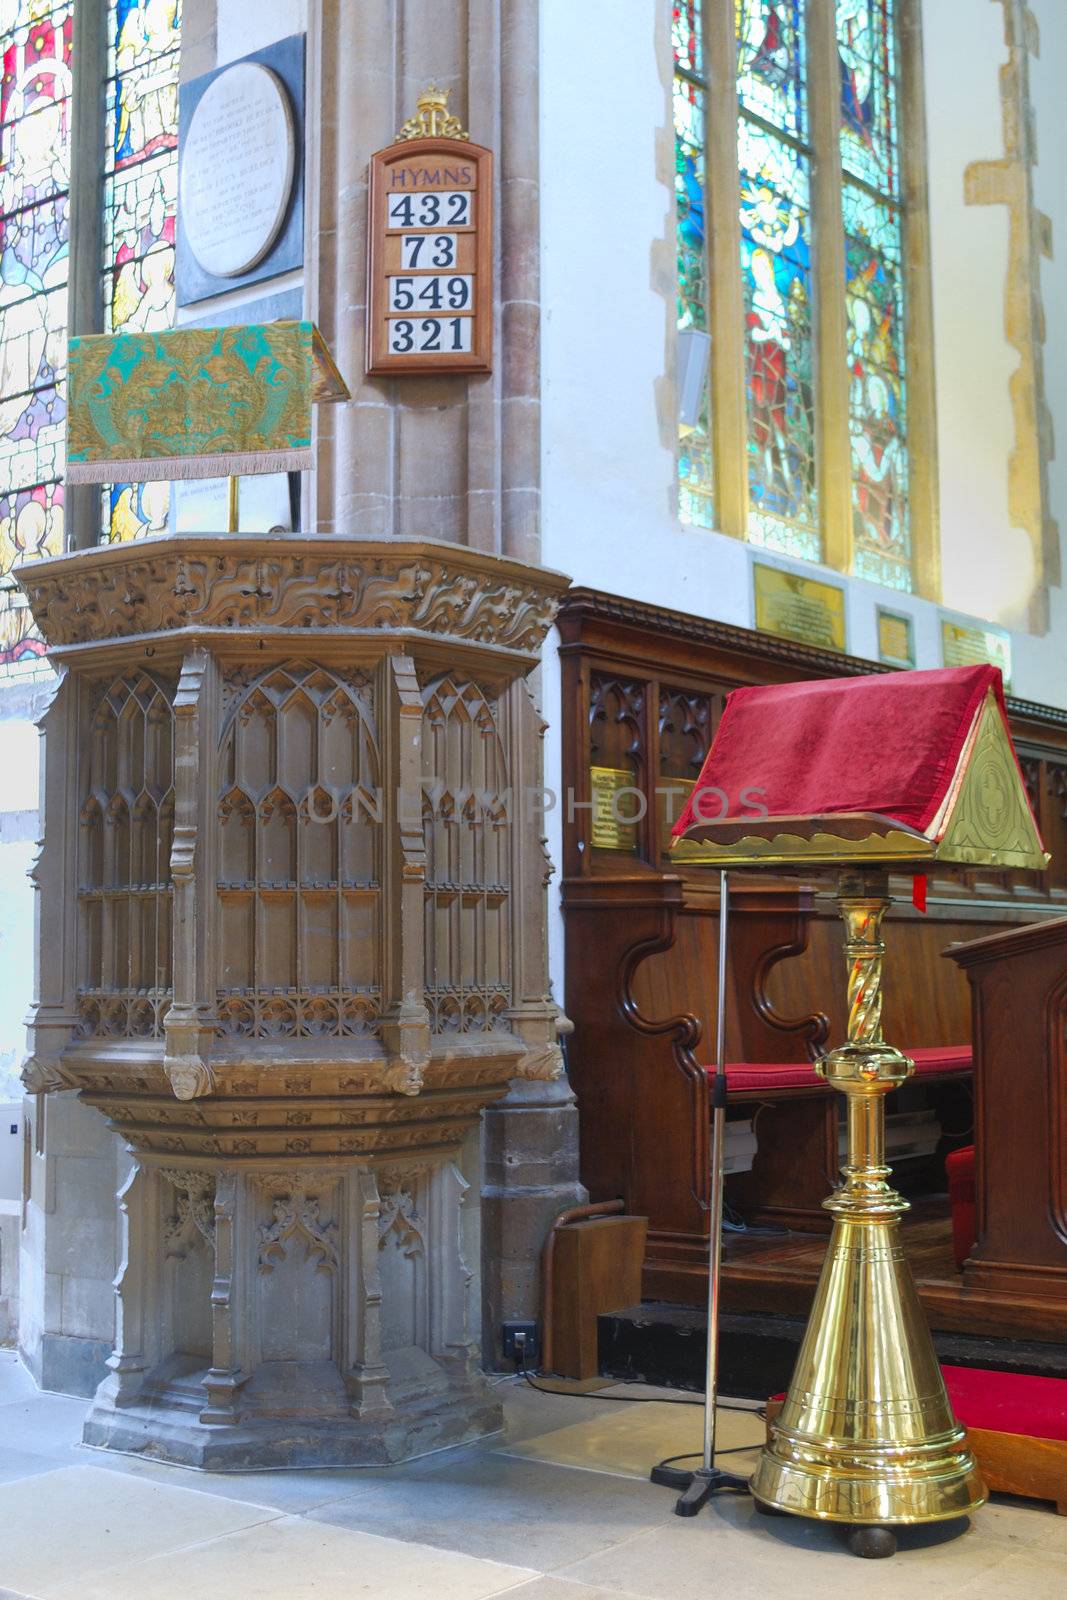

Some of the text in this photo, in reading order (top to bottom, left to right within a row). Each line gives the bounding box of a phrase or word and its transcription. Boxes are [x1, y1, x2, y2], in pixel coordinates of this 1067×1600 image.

[391, 166, 472, 188] HYMNS
[391, 194, 468, 227] 432
[405, 236, 454, 268] 73
[393, 277, 469, 310] 549
[392, 318, 463, 352] 321
